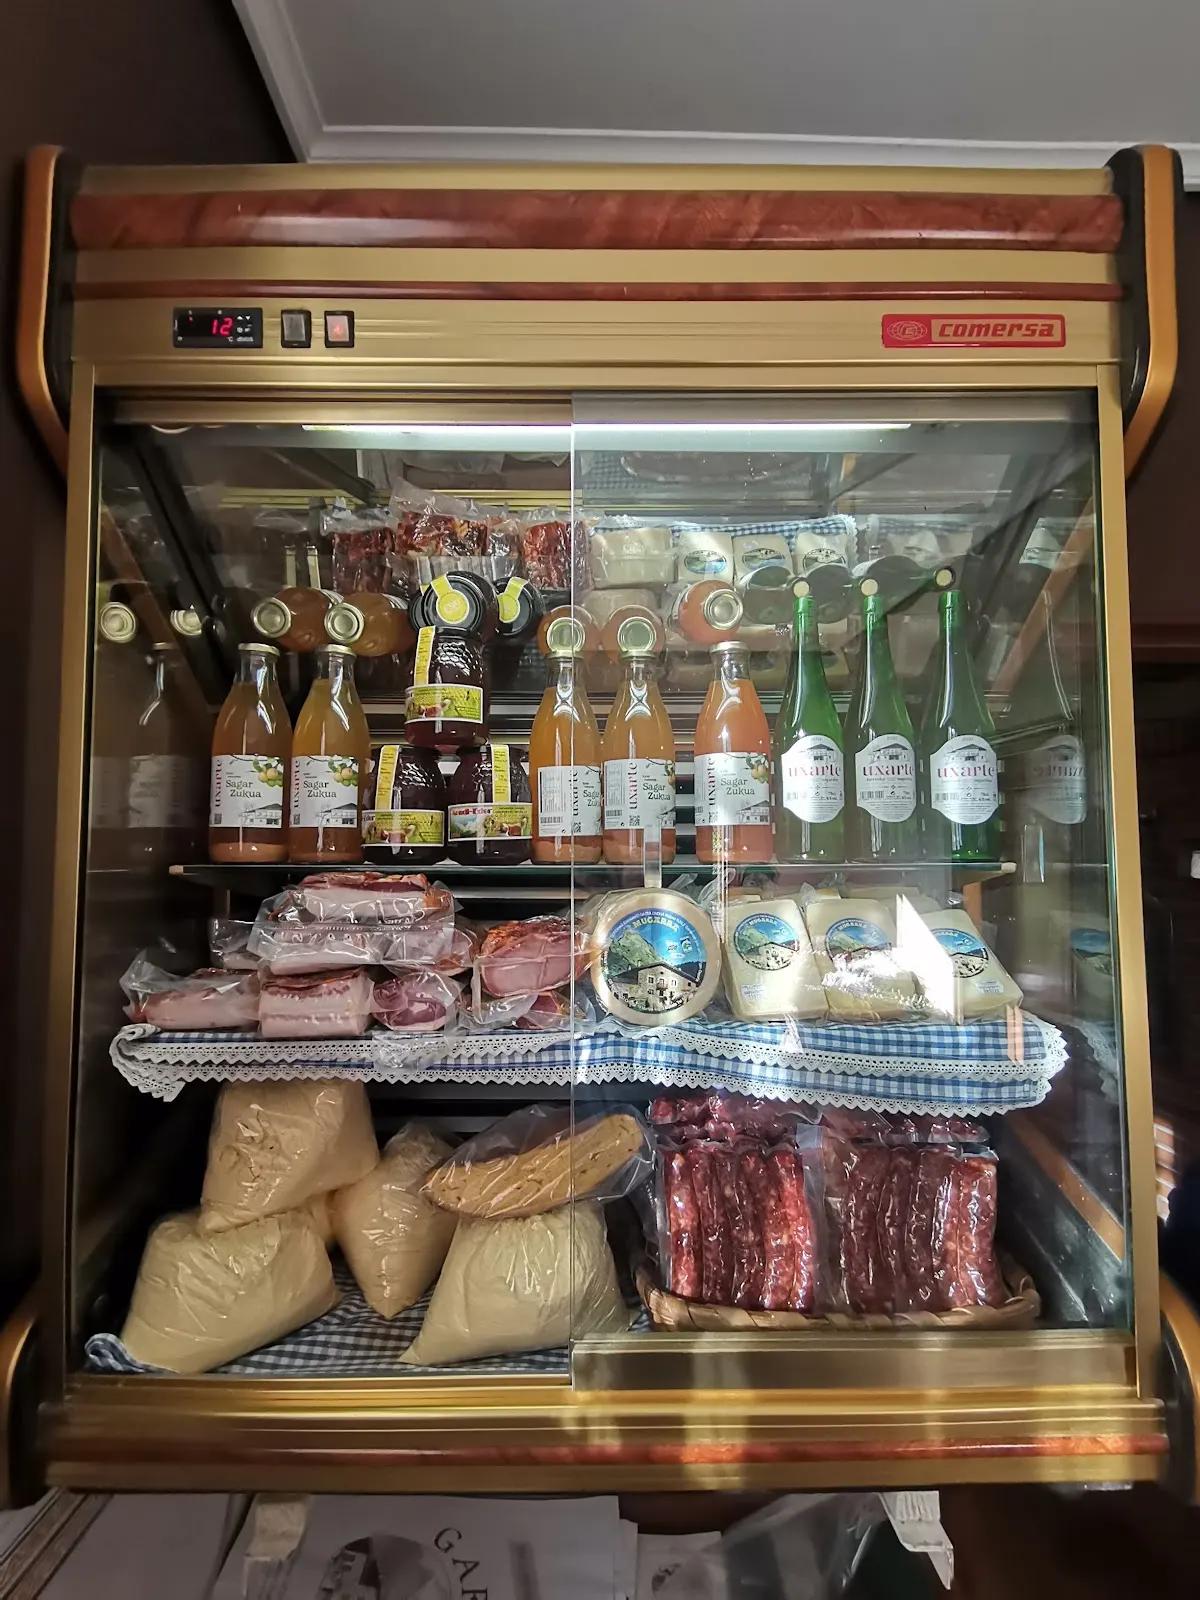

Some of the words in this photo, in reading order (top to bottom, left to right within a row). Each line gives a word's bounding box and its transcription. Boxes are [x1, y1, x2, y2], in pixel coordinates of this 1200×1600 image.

[212, 318, 233, 336] 12
[938, 323, 1055, 338] comersa
[788, 764, 841, 777] uxarte
[862, 764, 914, 777] uxarte
[937, 764, 996, 778] uxarte
[214, 759, 222, 808] uxarte
[225, 780, 254, 790] Sagar
[303, 780, 330, 789] Sagar
[628, 762, 638, 810] uxarte
[642, 782, 666, 792] Sagar
[707, 757, 716, 806] uxarte
[720, 777, 748, 787] Sagar
[230, 789, 262, 798] Zukua
[307, 789, 337, 798] Zukua
[647, 792, 671, 800] Zukua
[725, 787, 756, 796] Zukua
